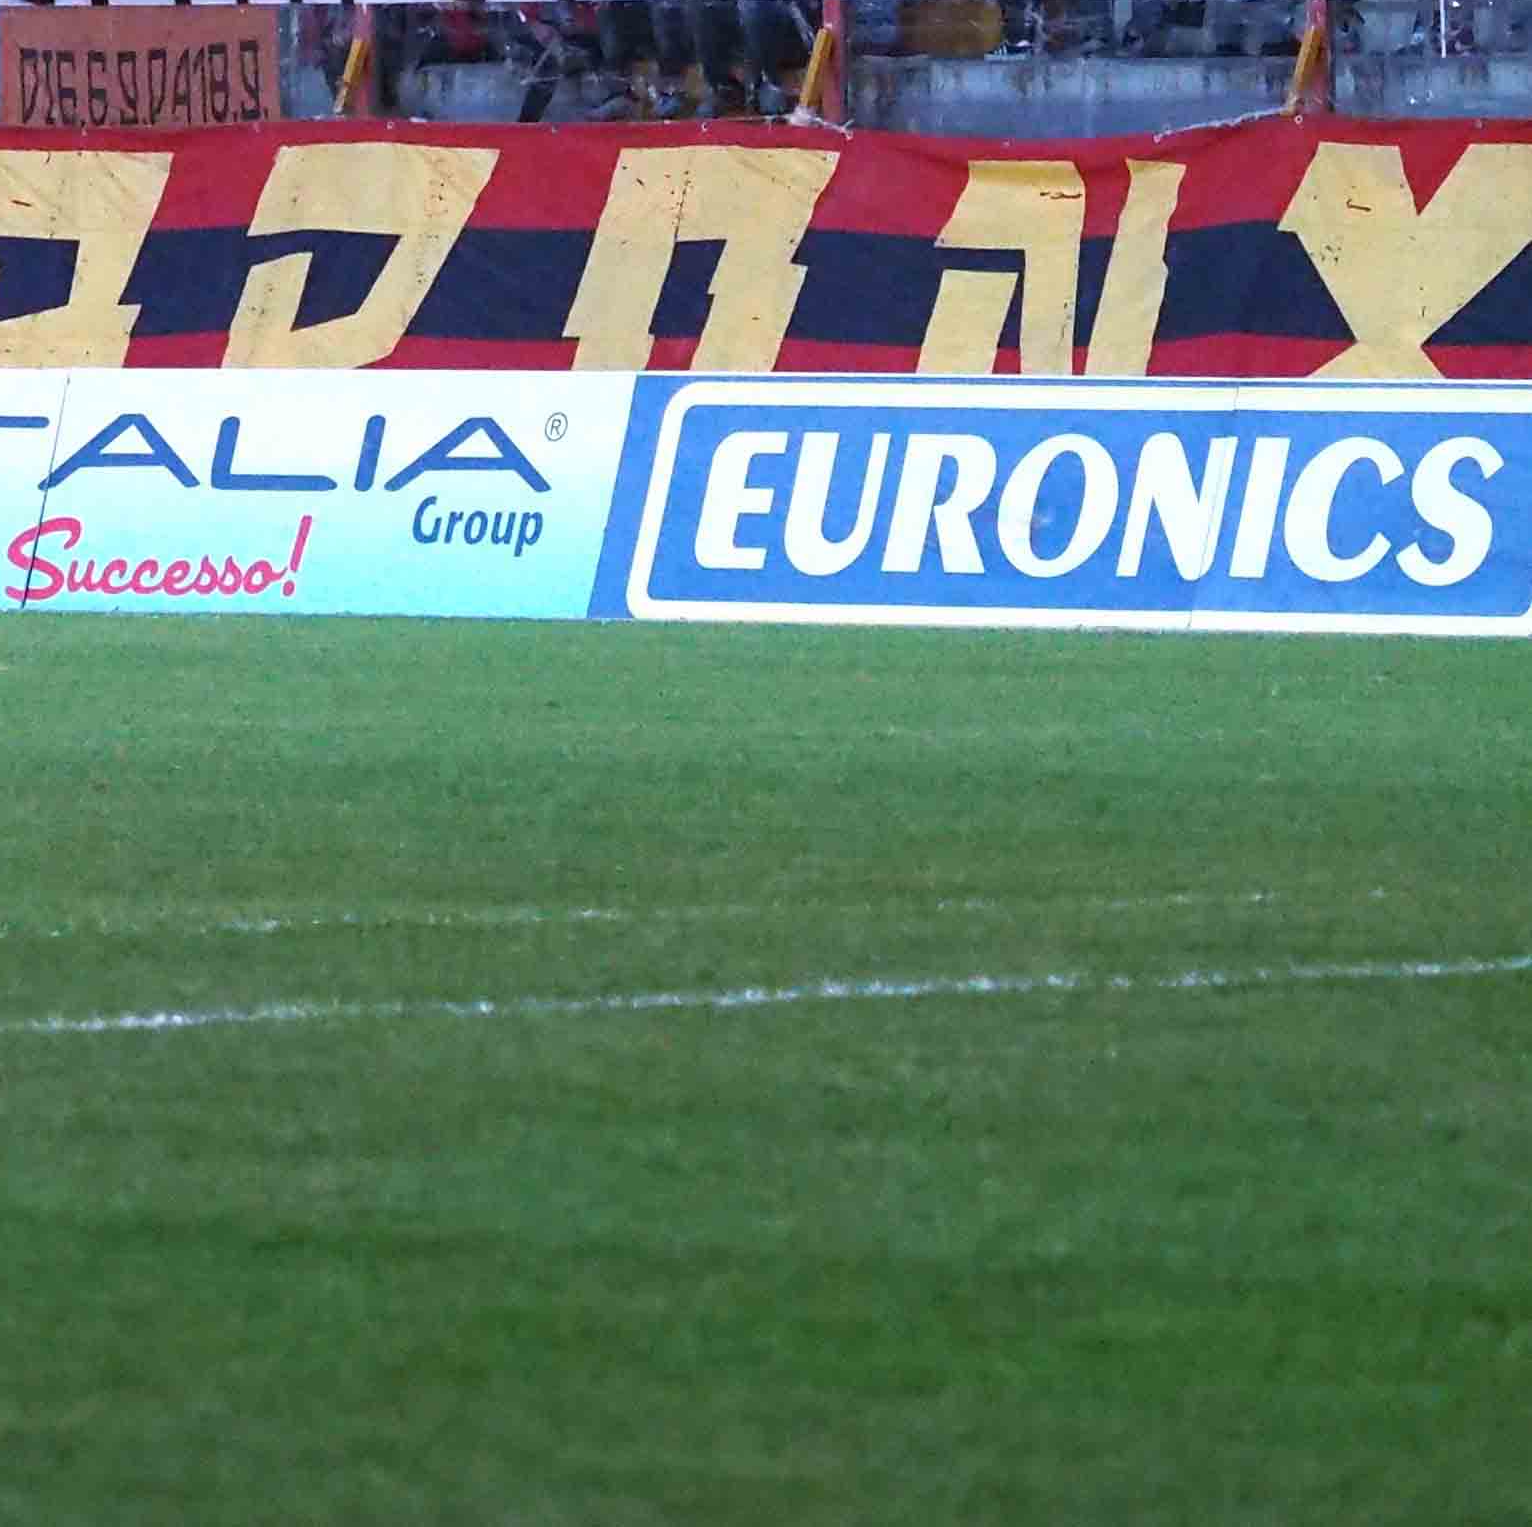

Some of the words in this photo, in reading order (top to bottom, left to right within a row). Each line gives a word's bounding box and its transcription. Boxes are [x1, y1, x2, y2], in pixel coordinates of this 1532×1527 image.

[411, 495, 545, 558] Group
[694, 429, 1506, 587] EURONICS
[4, 514, 314, 602] Successo!
